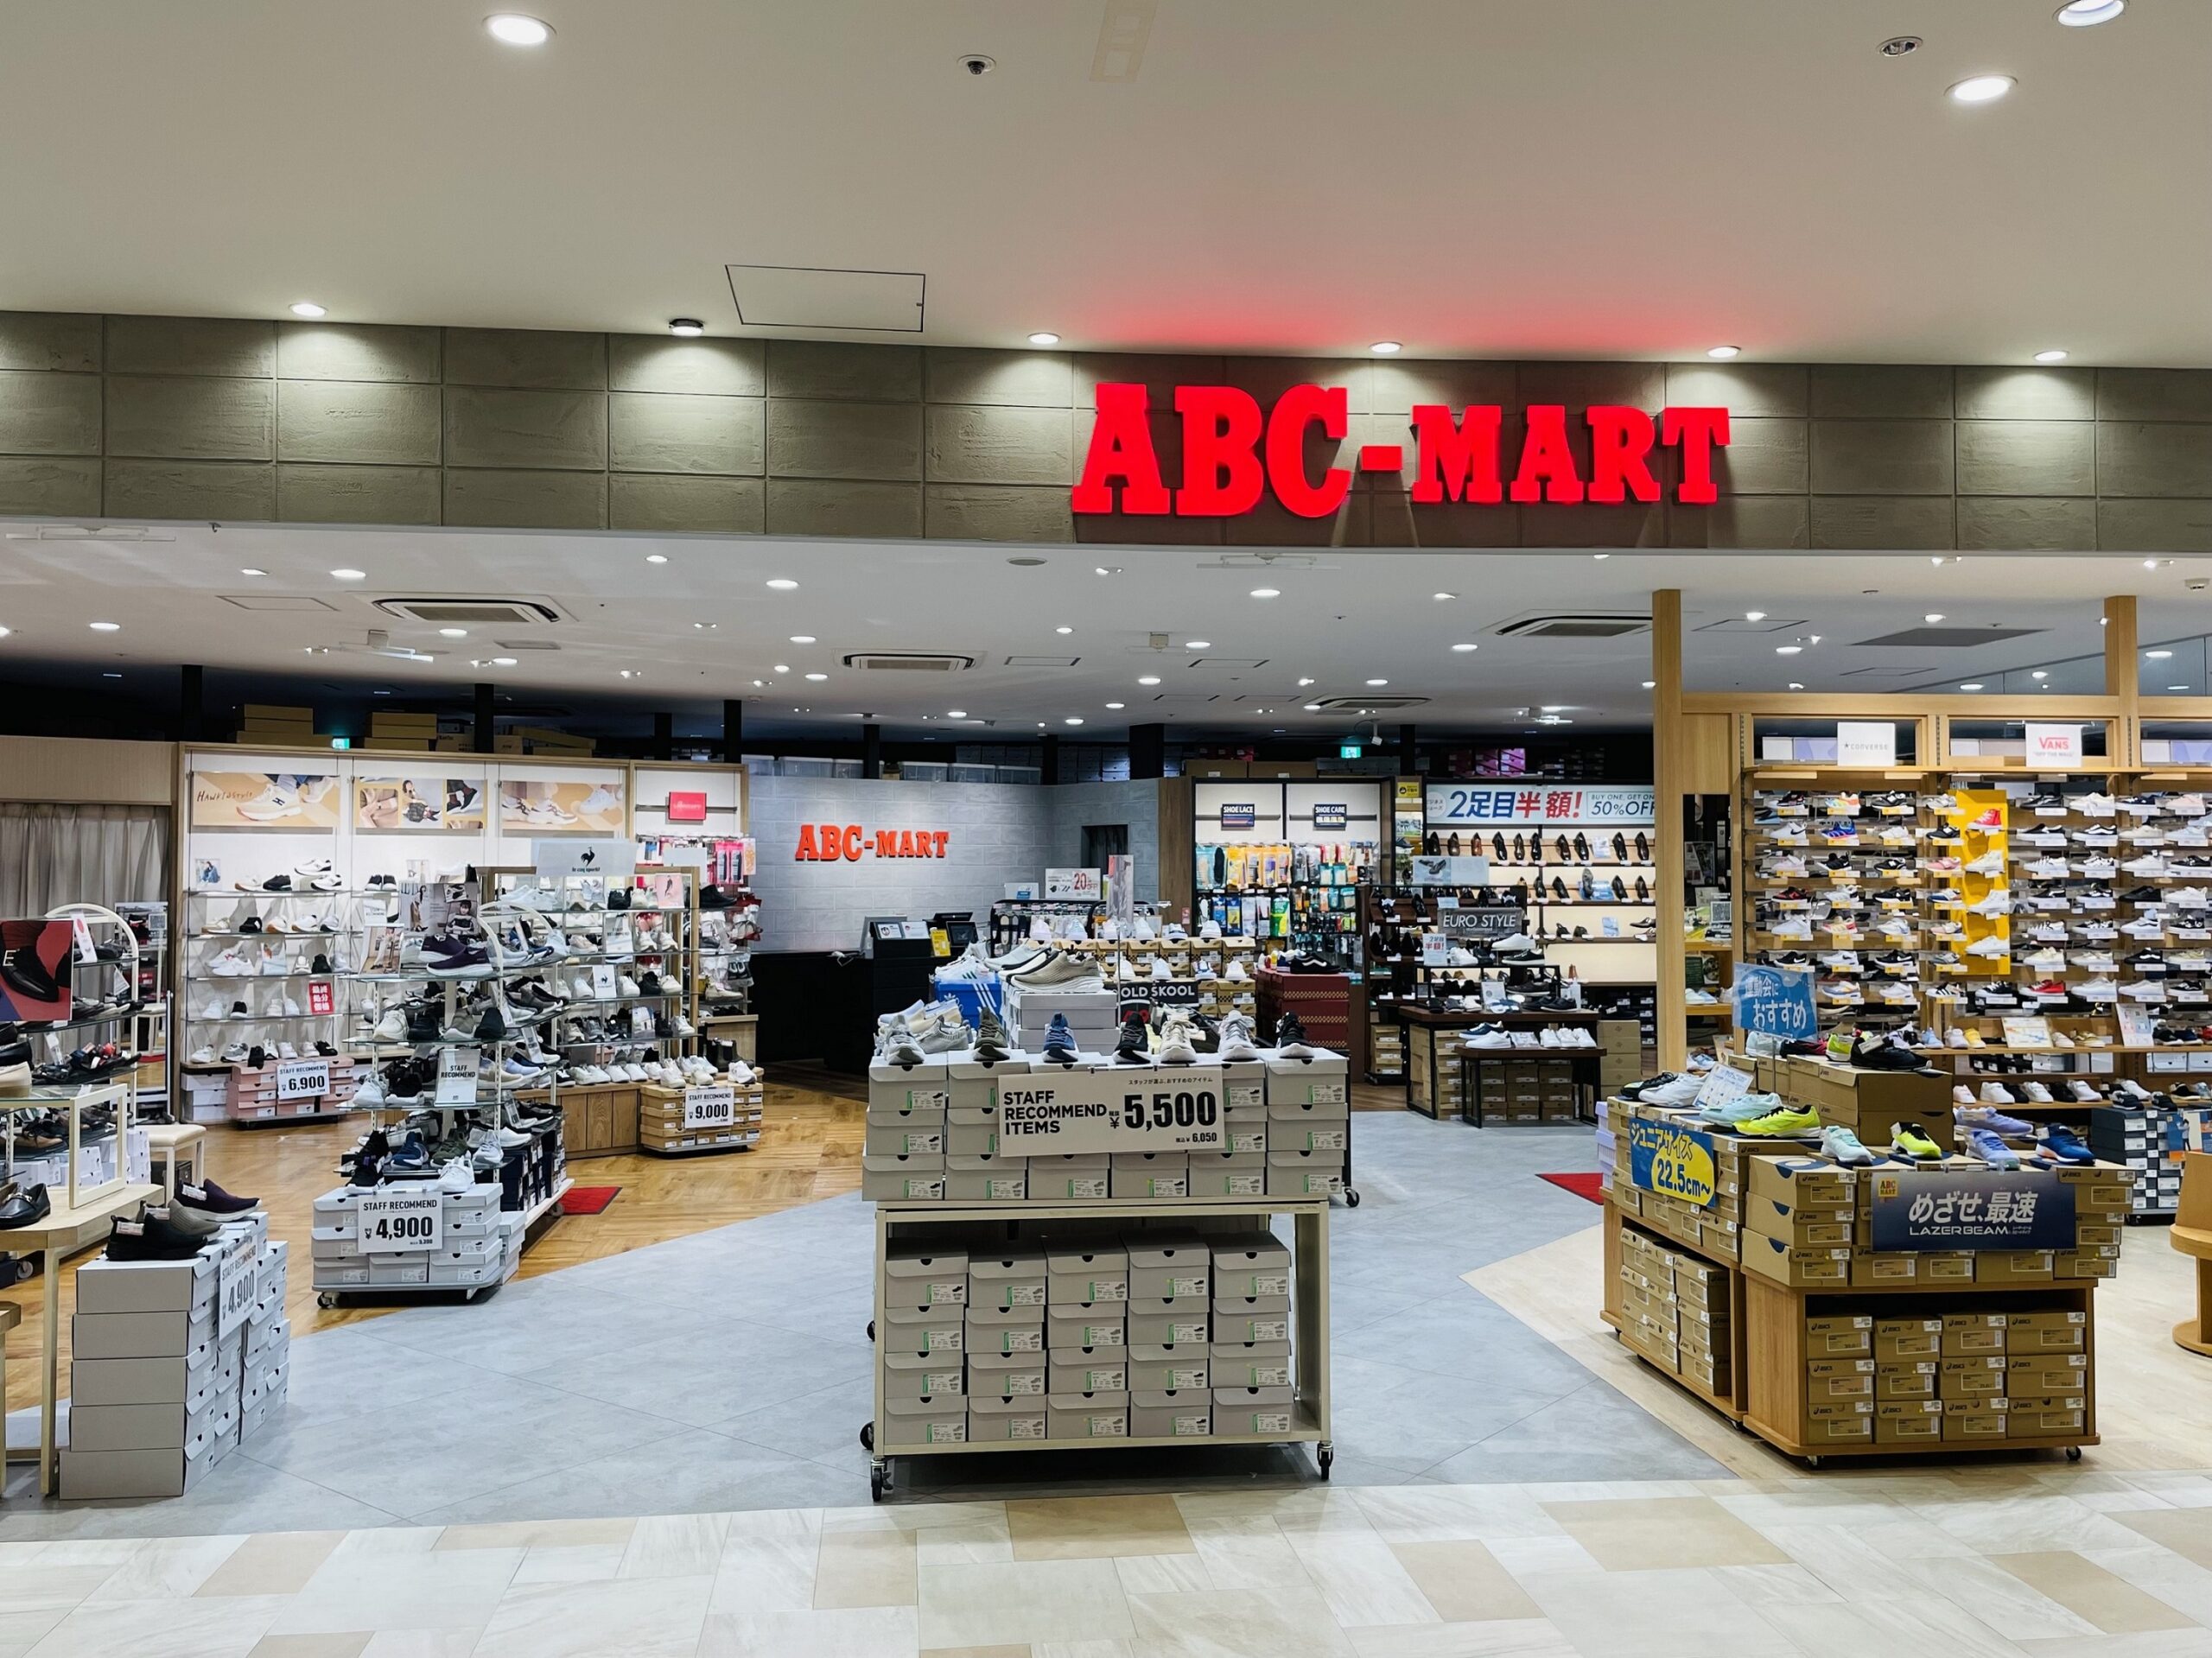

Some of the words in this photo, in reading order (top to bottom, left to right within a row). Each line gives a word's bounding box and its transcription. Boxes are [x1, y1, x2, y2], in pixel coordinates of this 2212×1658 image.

[1071, 383, 1731, 518] ABC-MART
[2039, 736, 2069, 750] VANS
[1447, 790, 1583, 818] 2足目半額!
[795, 824, 949, 862] ABC-MART
[1074, 873, 1087, 891] 20
[1443, 914, 1477, 927] EURO
[1481, 914, 1516, 927] STYLE
[1121, 987, 1148, 998] OLD
[1151, 985, 1195, 996] SKOOL
[1753, 998, 1807, 1030] おすすめ
[296, 1064, 327, 1073] RECOMMEND
[289, 1075, 325, 1091] 6,900
[1003, 1090, 1055, 1105] STAFF
[696, 1104, 728, 1120] 9,000
[1005, 1103, 1107, 1121] RECOMMEND
[1124, 1091, 1217, 1132] 5,500
[1005, 1121, 1061, 1135] ITEMS
[1192, 1133, 1217, 1143] 6,050
[1630, 1122, 1693, 1161] ジュニアサイズ
[1880, 1180, 1896, 1189] ABC
[364, 1202, 387, 1211] STAFF
[390, 1199, 437, 1210] RECOMMEND
[1909, 1190, 2039, 1224] めざせ、最速
[376, 1216, 433, 1241] 4,900
[1910, 1226, 2008, 1236] LAZERBEAM
[222, 1261, 234, 1280] STAFF
[228, 1269, 254, 1313] 4,900
